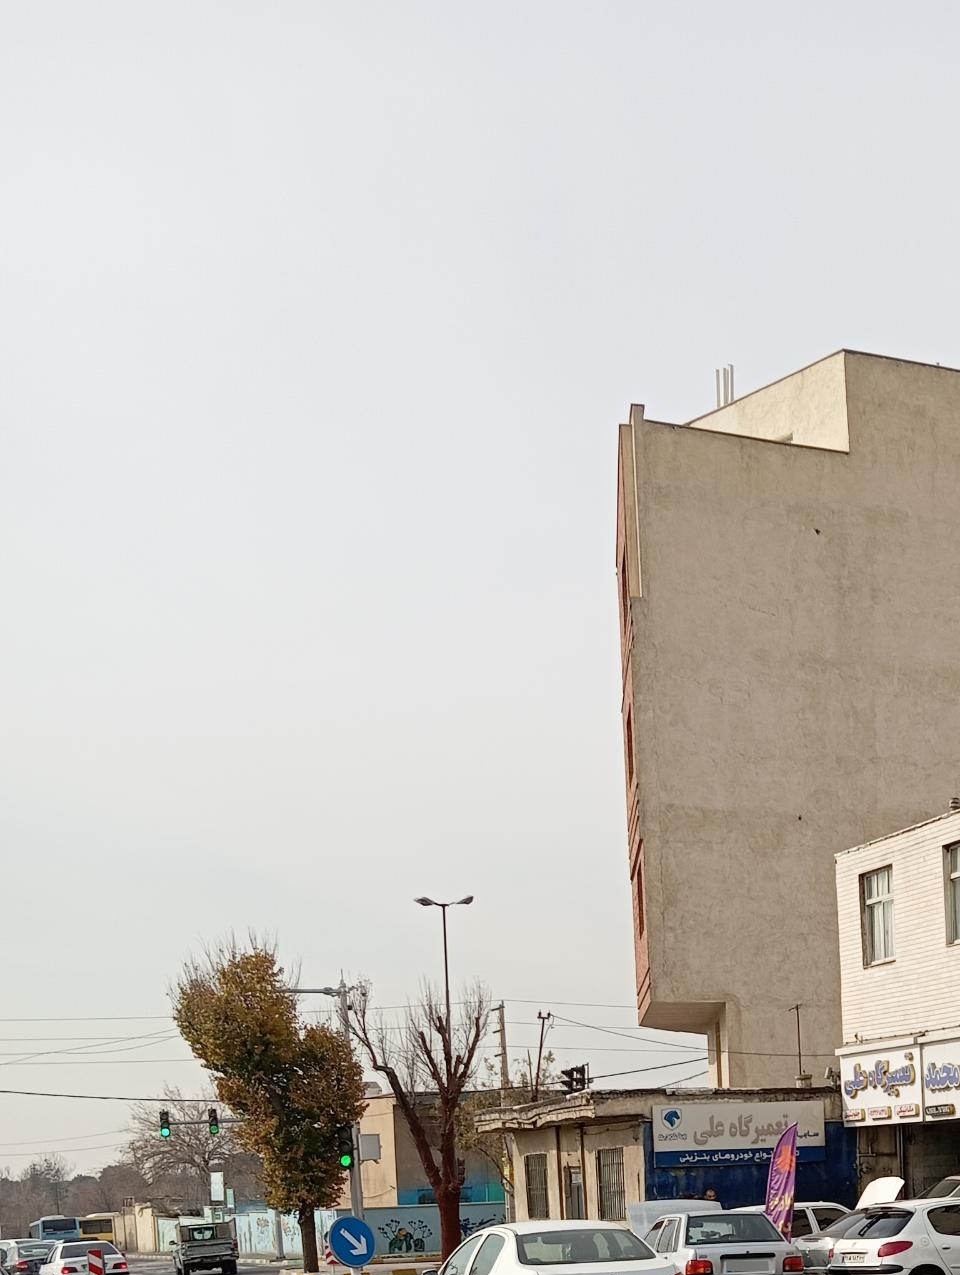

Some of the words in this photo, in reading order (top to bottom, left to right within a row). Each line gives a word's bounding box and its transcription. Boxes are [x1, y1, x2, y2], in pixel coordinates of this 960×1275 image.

[845, 1063, 868, 1098] علی
[694, 1114, 724, 1146] علی
[729, 1113, 788, 1144] تعمیرگاه
[680, 1151, 711, 1163] بنزینی
[712, 1151, 753, 1162] خودروهای
